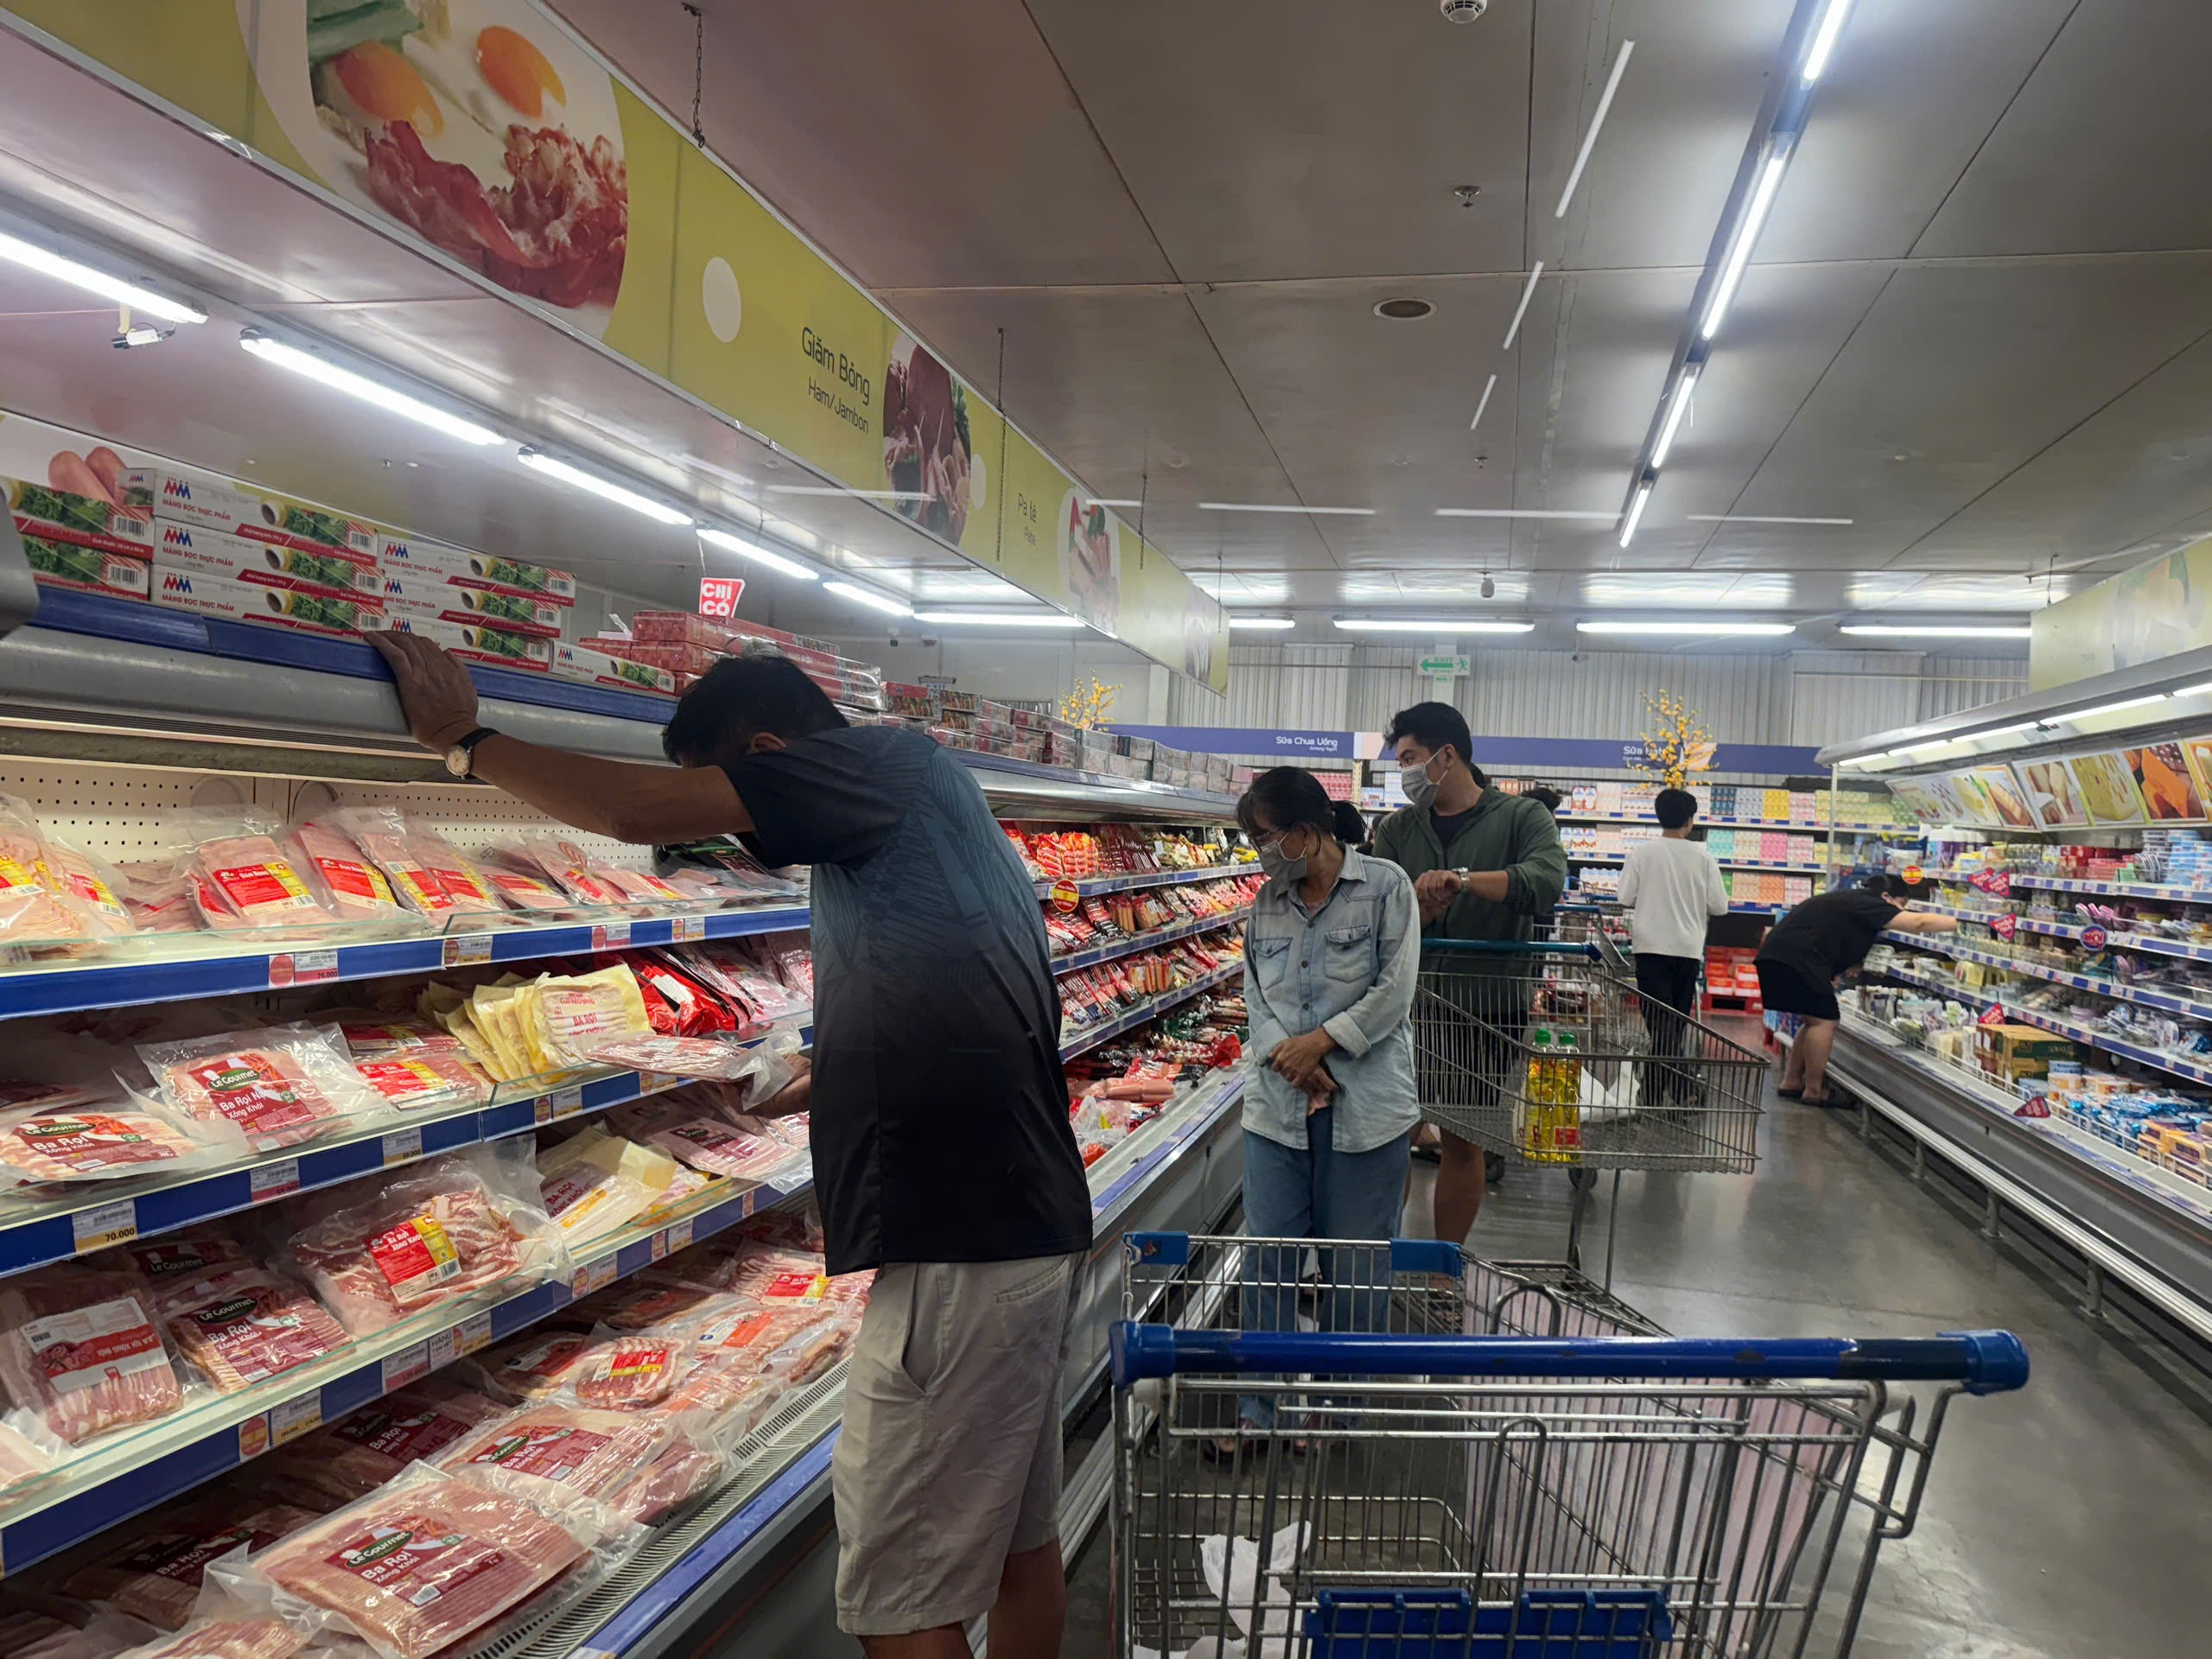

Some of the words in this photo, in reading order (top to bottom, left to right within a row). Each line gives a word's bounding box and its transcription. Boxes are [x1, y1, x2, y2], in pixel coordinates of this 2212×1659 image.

[802, 326, 835, 374] Giăm
[702, 599, 730, 617] CÓ
[1275, 736, 1293, 745] Sữa
[1316, 737, 1338, 748] Uống
[1623, 746, 1643, 755] Sữa
[316, 970, 338, 980] 76.000
[219, 1101, 235, 1112] Ba
[234, 1093, 252, 1107] Rọi
[227, 1109, 247, 1120] Xông
[246, 1102, 264, 1114] Khói
[32, 1141, 55, 1151] Ba
[56, 1134, 88, 1147] Rọi
[105, 1227, 135, 1243] 70.000
[207, 1331, 228, 1344] Ba
[369, 1438, 387, 1450] Ba
[380, 1427, 402, 1440] Rọi
[501, 1457, 520, 1468] Ba
[360, 1567, 385, 1580] Ba
[383, 1550, 412, 1567] Rọi
[372, 1568, 401, 1585] Xông
